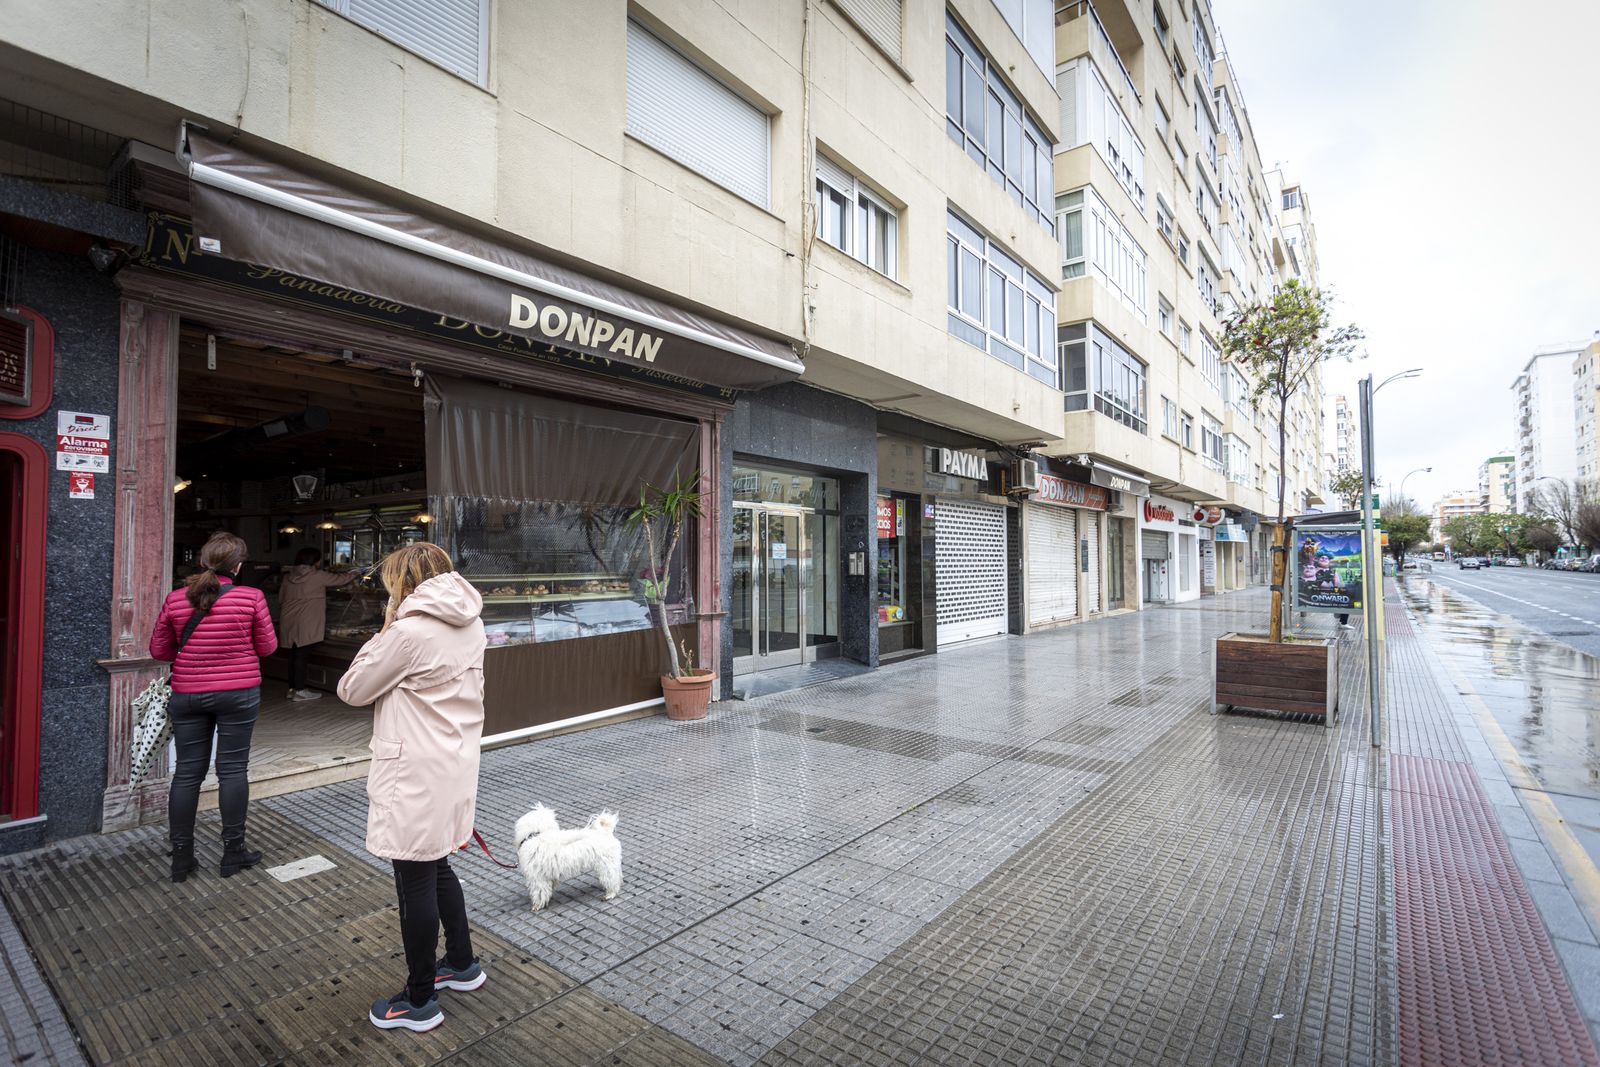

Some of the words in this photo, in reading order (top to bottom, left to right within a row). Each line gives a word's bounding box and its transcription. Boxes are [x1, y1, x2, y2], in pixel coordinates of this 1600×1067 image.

[509, 293, 663, 363] DONPAN
[67, 424, 102, 433] Direct
[60, 436, 107, 449] Alarma
[942, 448, 988, 481] PAYMA
[1041, 478, 1063, 500] DON
[1067, 482, 1085, 504] PAN
[1110, 476, 1131, 491] DONPAN
[1311, 595, 1350, 603] ONWARD
